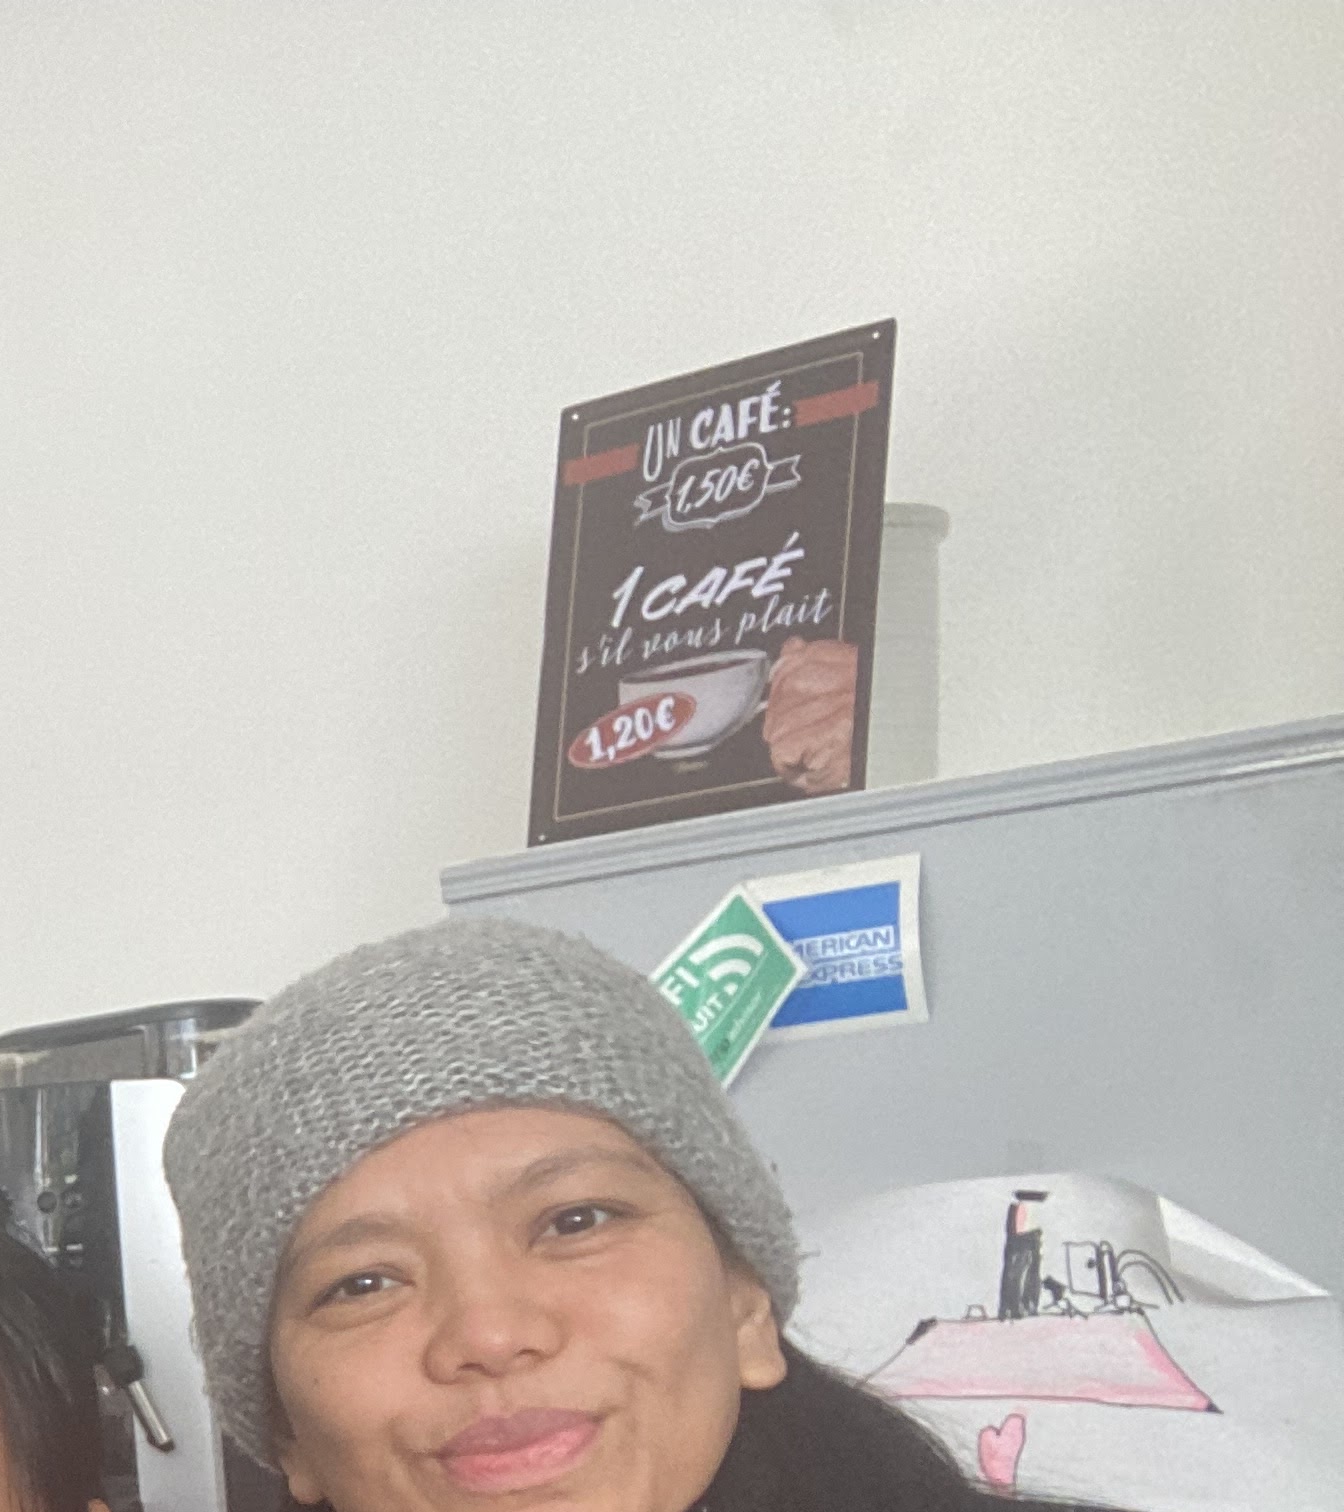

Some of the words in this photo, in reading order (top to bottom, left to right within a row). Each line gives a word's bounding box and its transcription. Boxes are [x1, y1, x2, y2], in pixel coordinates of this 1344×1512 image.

[643, 416, 682, 482] UN
[689, 379, 792, 450] CAFÉ:
[675, 458, 760, 513] 1,50€
[612, 566, 645, 628] 1
[641, 531, 805, 621] CAFÉ
[643, 618, 722, 660] vous
[734, 587, 832, 645] plait
[584, 696, 676, 762] 1,20€
[795, 930, 891, 957] ERICAN
[807, 953, 903, 982] XPRESS
